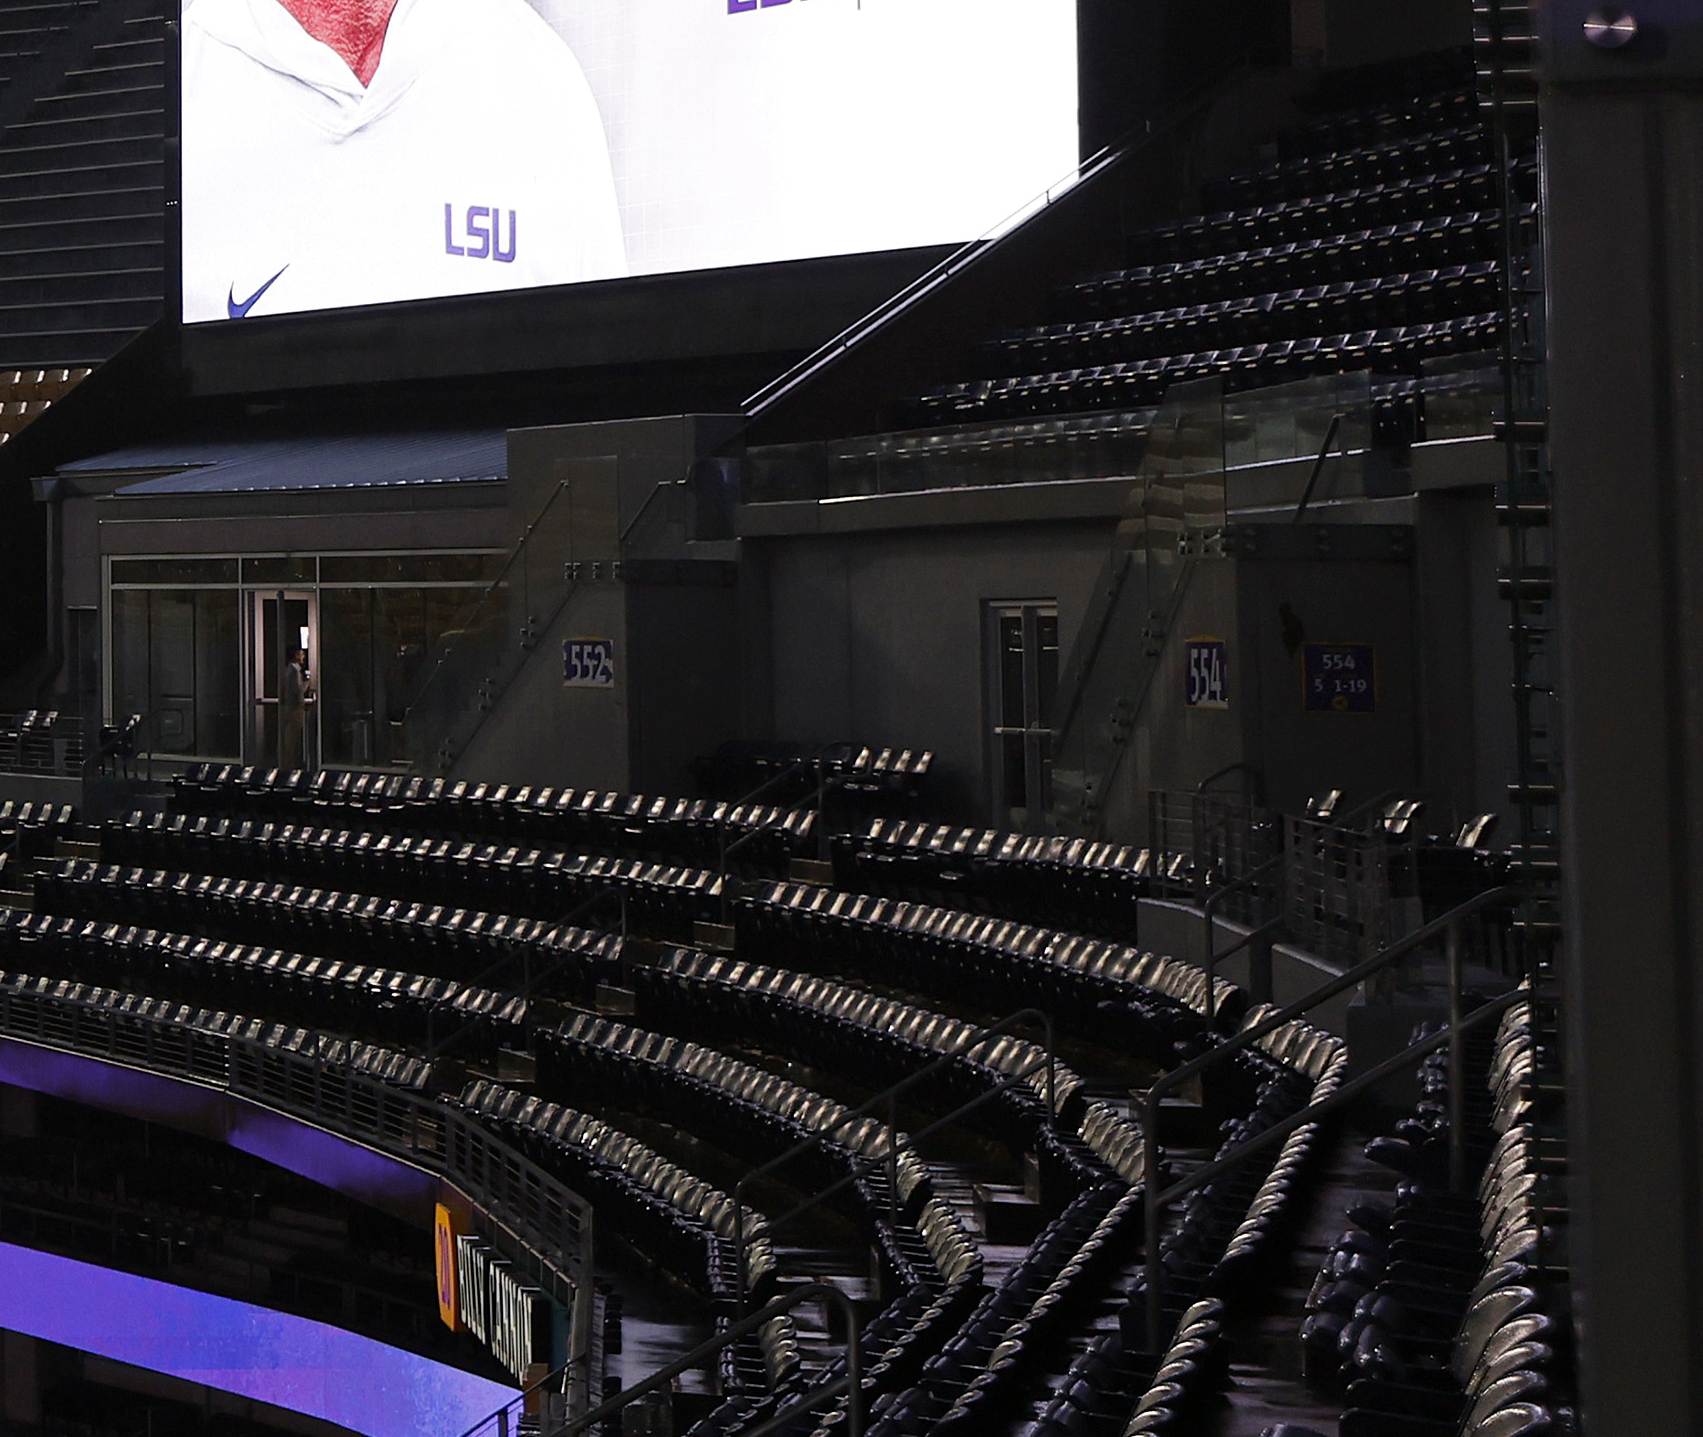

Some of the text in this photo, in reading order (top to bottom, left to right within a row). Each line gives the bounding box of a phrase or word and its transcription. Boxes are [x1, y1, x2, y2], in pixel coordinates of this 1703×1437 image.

[444, 203, 516, 263] LSU
[571, 645, 607, 683] 552
[1190, 648, 1222, 701] 554
[1321, 654, 1356, 670] 554
[1334, 679, 1367, 693] 1-19
